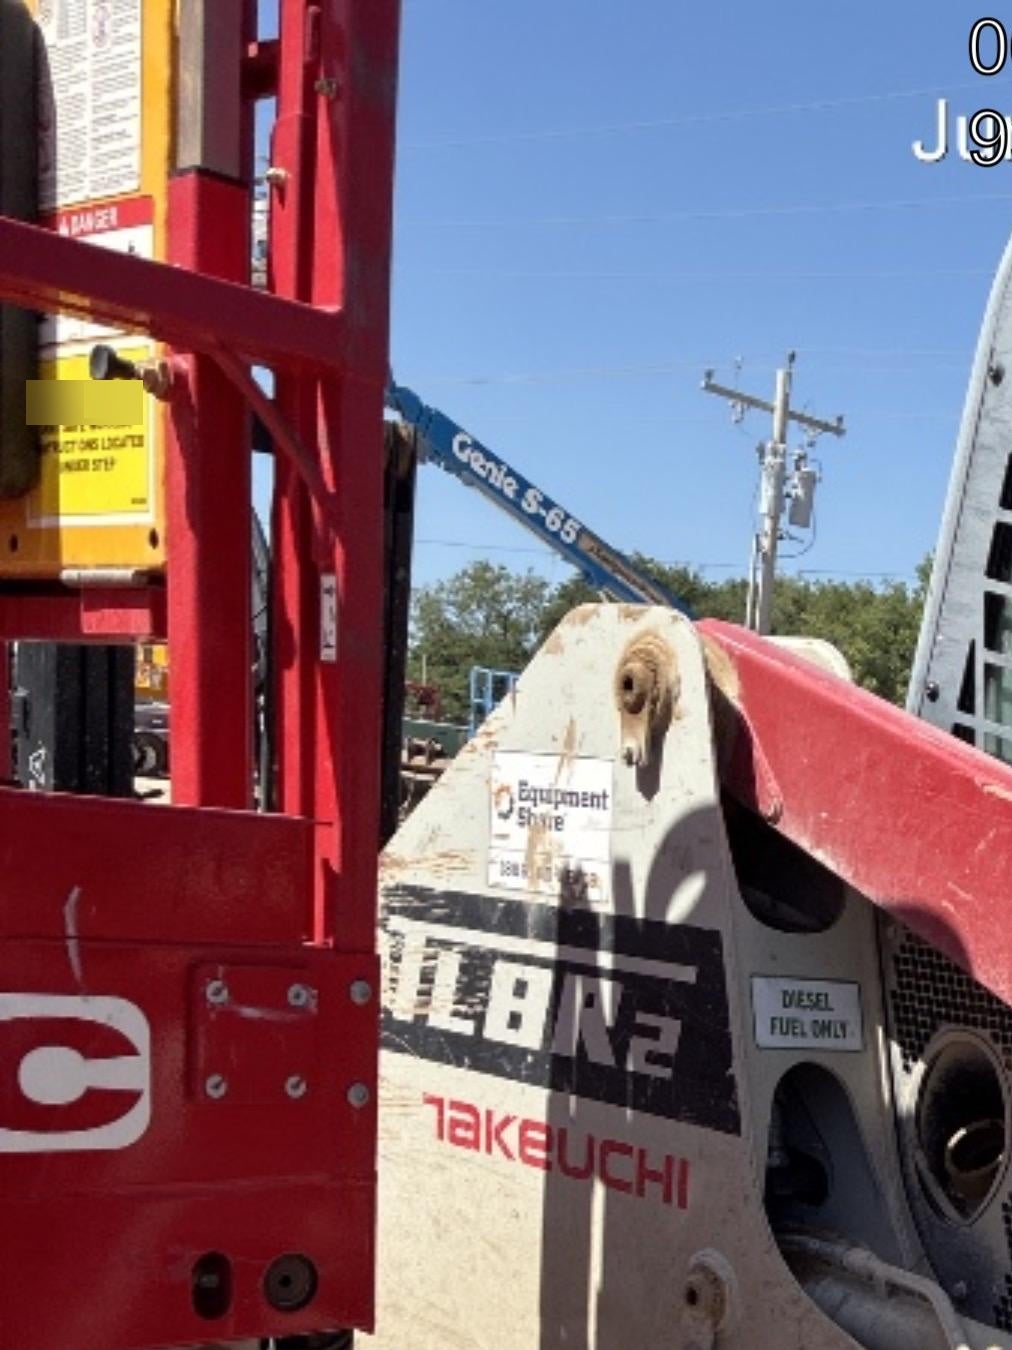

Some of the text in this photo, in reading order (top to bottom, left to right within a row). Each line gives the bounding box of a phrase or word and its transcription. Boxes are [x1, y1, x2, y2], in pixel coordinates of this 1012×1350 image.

[451, 431, 582, 545] Genie S-65
[517, 779, 609, 811] Equipment
[516, 806, 566, 832] Share
[781, 989, 834, 1012] DIESEL
[769, 1016, 850, 1039] FUEL ONLY
